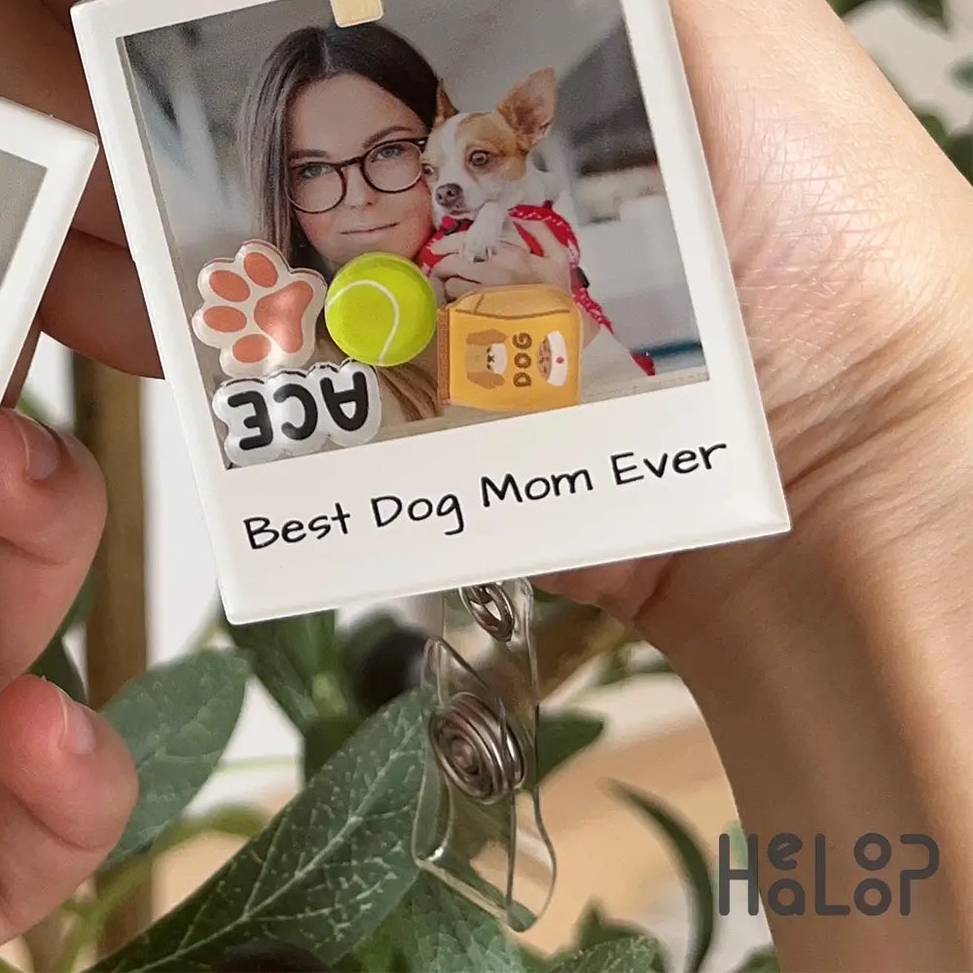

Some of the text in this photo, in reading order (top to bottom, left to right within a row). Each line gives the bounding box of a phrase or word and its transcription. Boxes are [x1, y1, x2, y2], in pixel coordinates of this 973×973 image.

[512, 332, 533, 388] DOG
[227, 369, 370, 452] ACE
[243, 443, 727, 550] Best Dog Mom Ever
